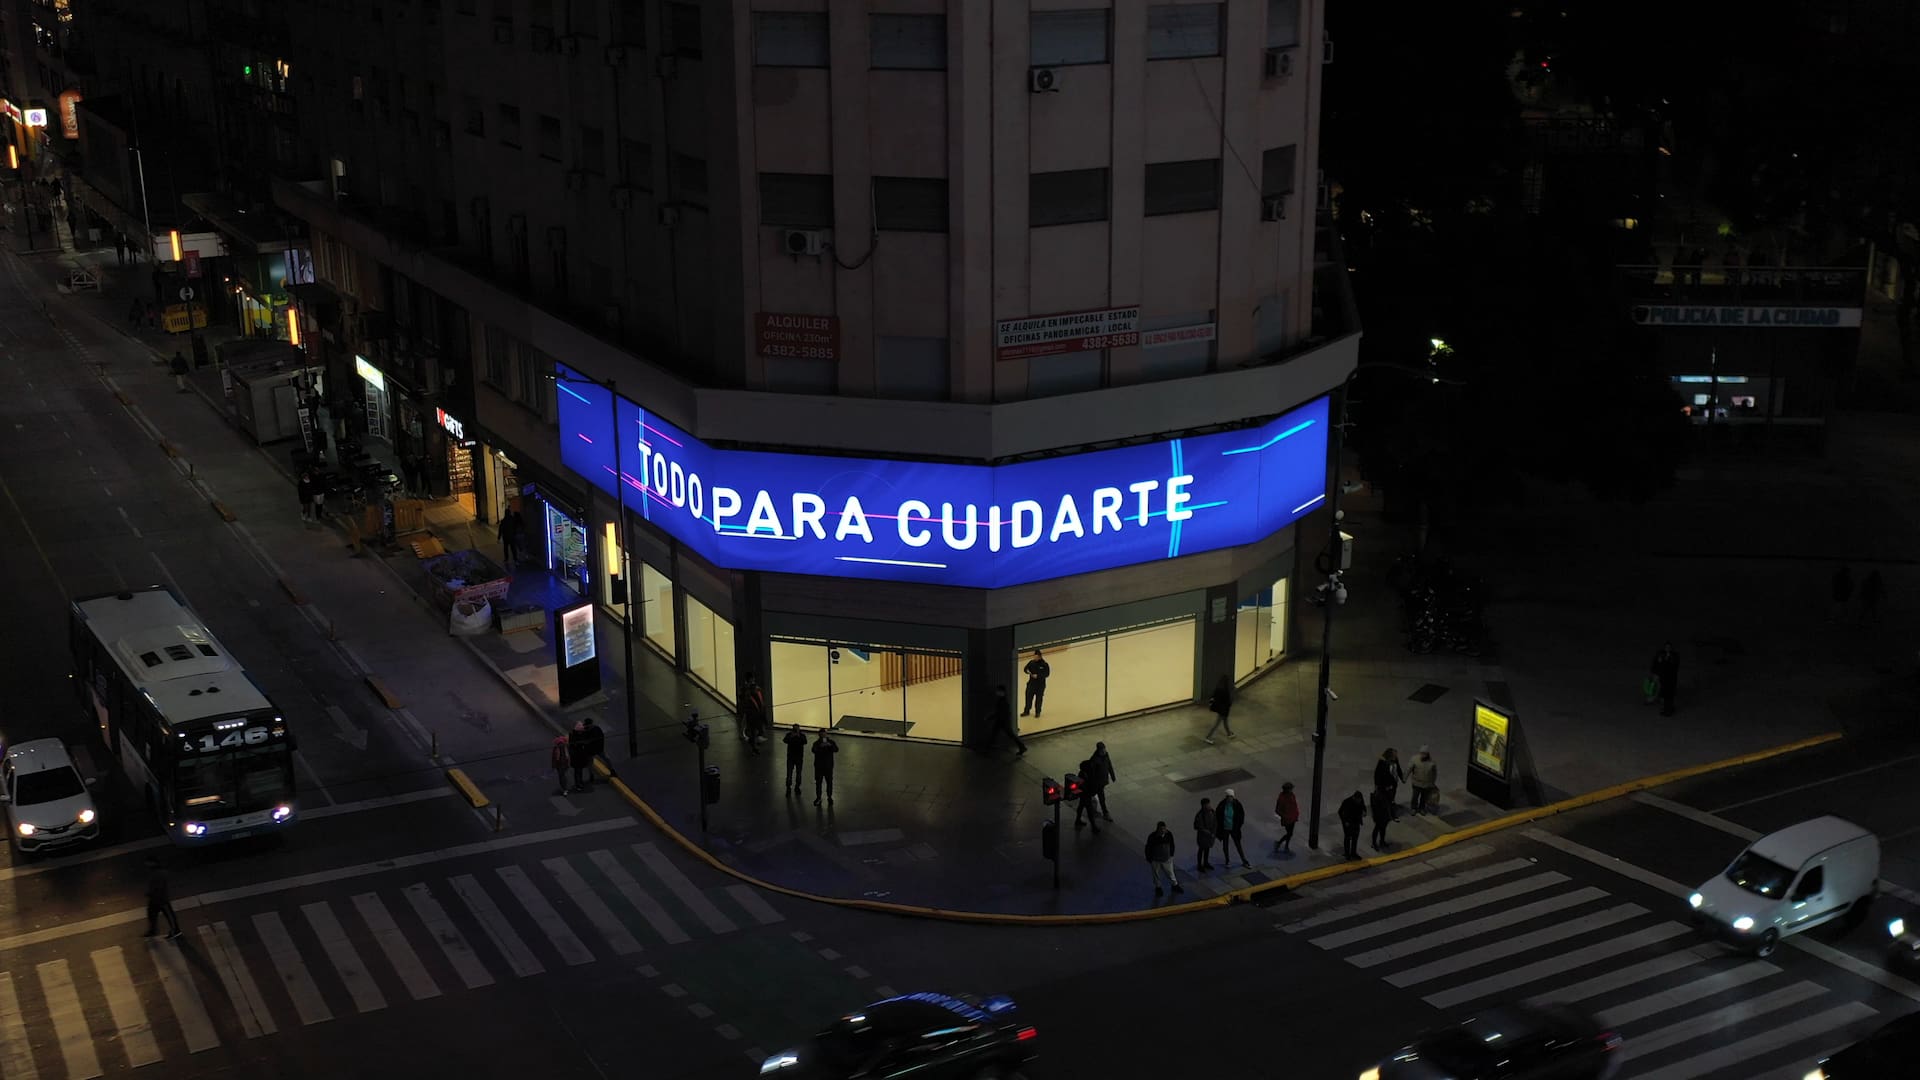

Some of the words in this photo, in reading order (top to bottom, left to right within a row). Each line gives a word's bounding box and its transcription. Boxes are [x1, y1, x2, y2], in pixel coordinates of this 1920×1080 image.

[767, 315, 829, 330] ALQUILER
[1000, 323, 1010, 332] SE
[1013, 320, 1046, 331] ALQUILA
[1048, 319, 1057, 327] EN
[1059, 313, 1103, 326] IMPECABLE
[1108, 309, 1137, 321] ESTADO
[1720, 308, 1744, 324] DE
[1748, 308, 1771, 325] LA
[1774, 308, 1840, 326] CIUDAD
[763, 330, 802, 342] OFICINA
[1003, 332, 1041, 344] OFICINAS
[1043, 325, 1100, 339] PANORAMICAS
[1108, 321, 1132, 333] LOCAL
[1081, 333, 1138, 350] 4382-5638
[762, 344, 834, 359] 4382-5885
[638, 441, 703, 519] TODO
[712, 486, 874, 544] PARA
[897, 474, 1194, 553] CUIDARTE
[198, 726, 269, 753] 146
